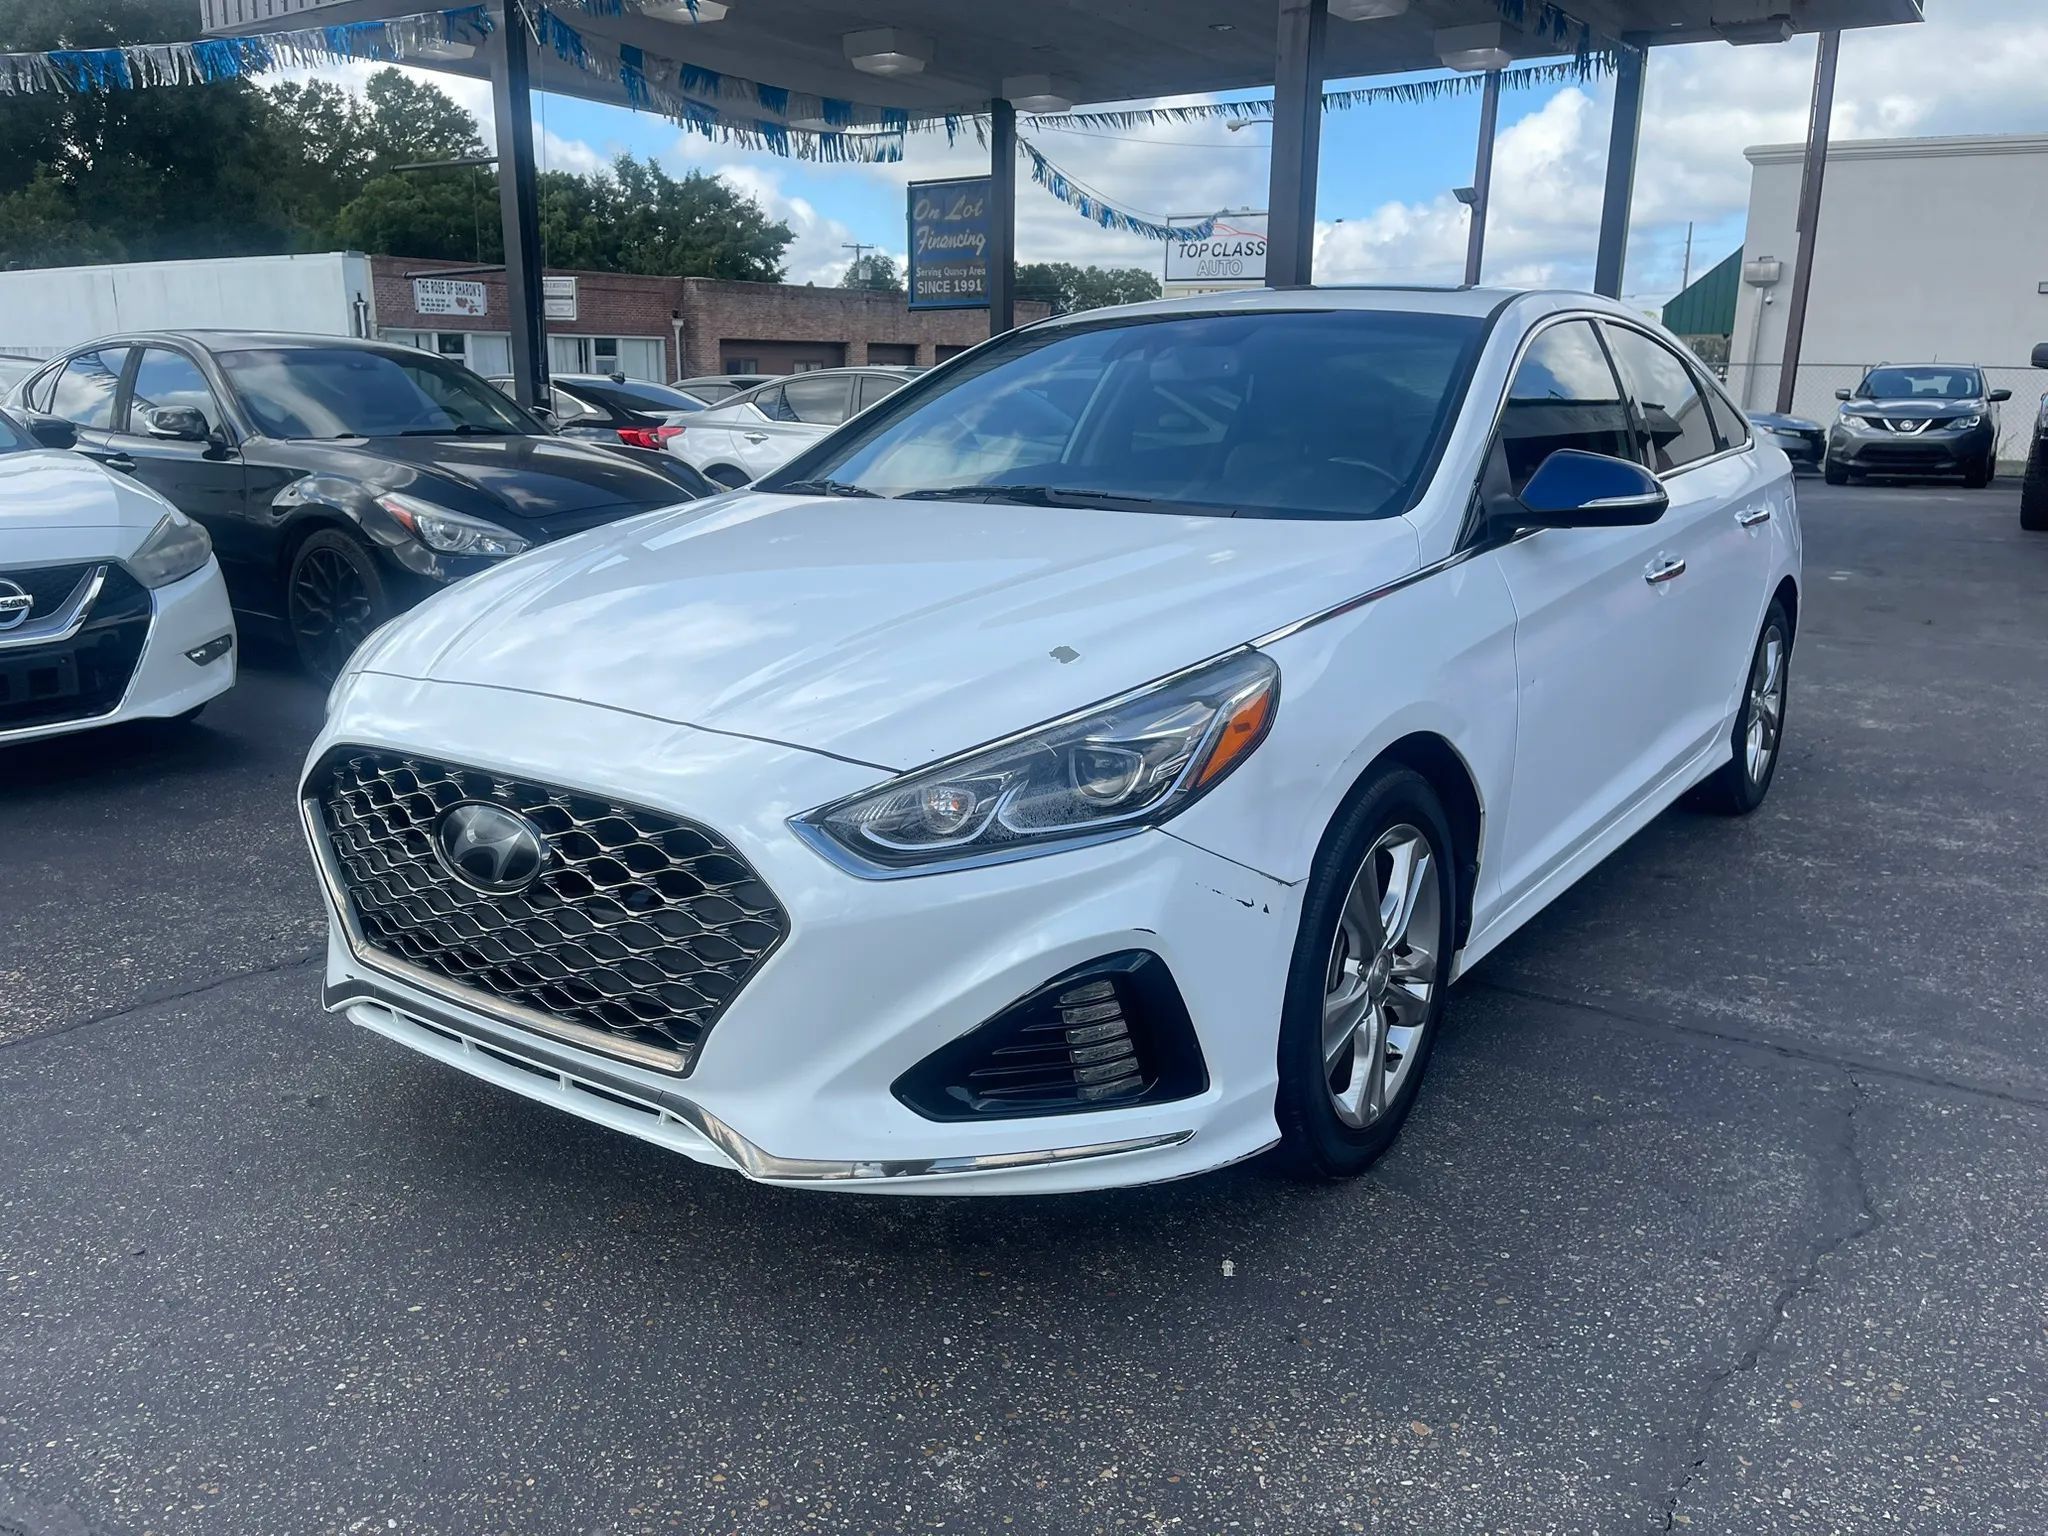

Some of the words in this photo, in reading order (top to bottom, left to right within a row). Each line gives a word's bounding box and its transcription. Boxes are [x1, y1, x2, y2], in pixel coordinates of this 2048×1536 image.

[914, 199, 939, 221] On
[944, 195, 983, 220] Lot
[917, 226, 986, 256] Financing
[1179, 243, 1209, 258] TOP
[1211, 241, 1266, 257] CLASS
[916, 267, 942, 278] Serving
[968, 266, 986, 276] Area
[1197, 259, 1243, 276] AUTO
[418, 280, 430, 293] THE
[430, 281, 446, 294] ROSE
[446, 282, 453, 295] OF
[917, 281, 951, 294] SINCE
[953, 279, 982, 292] 1991
